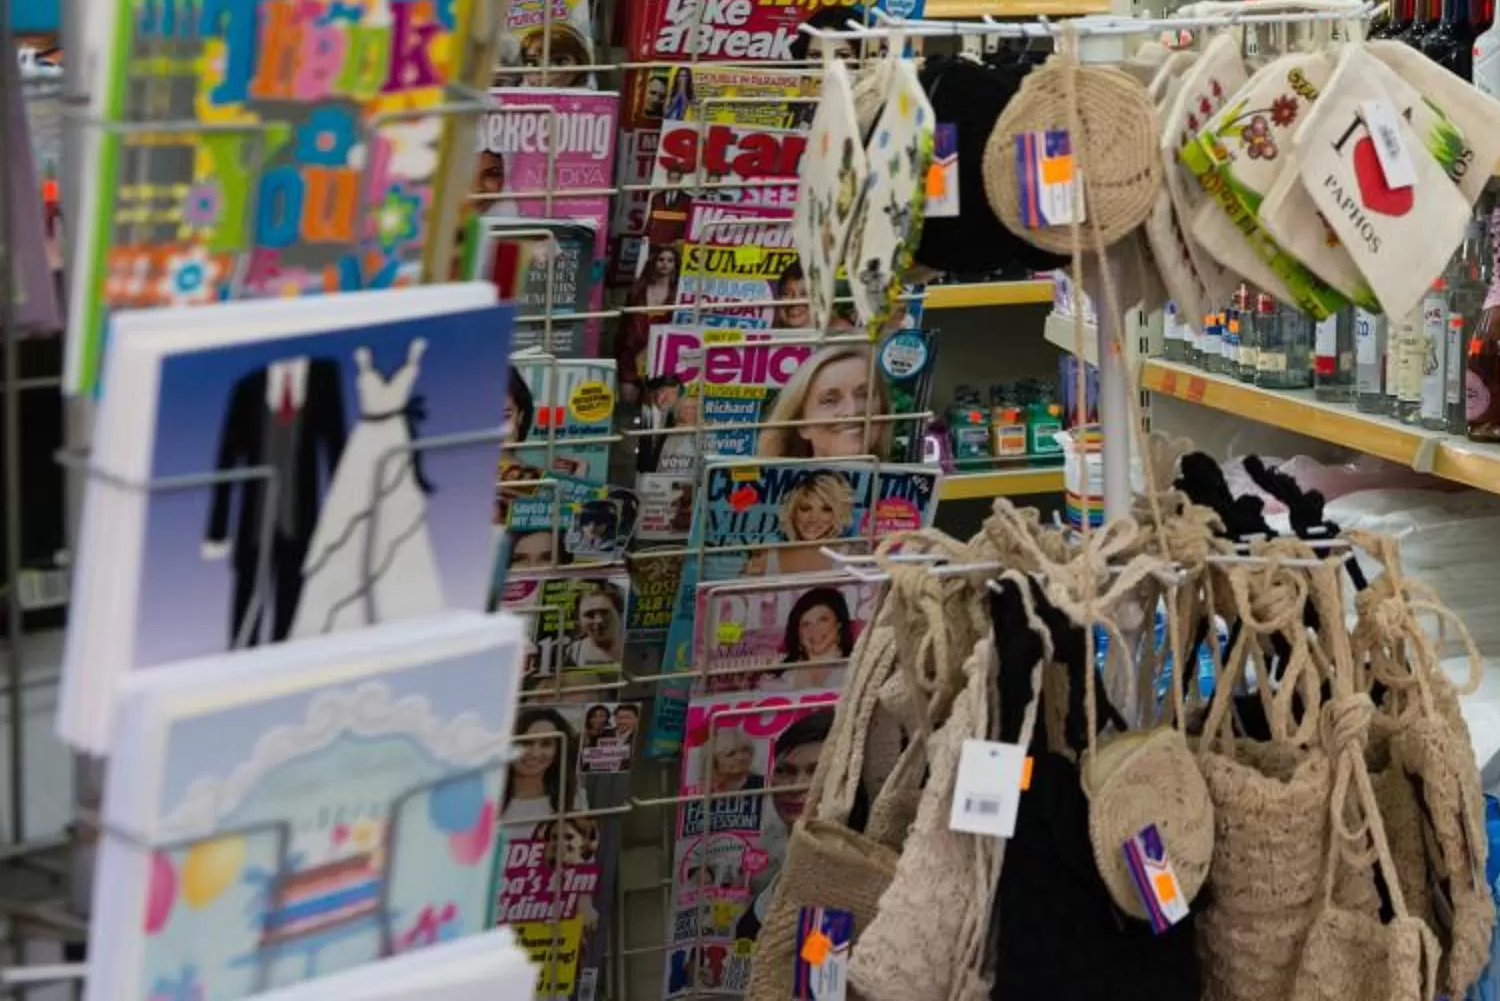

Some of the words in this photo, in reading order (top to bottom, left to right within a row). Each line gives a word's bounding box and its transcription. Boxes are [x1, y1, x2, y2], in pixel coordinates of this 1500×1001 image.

[658, 125, 808, 178] star
[522, 166, 605, 185] NDIYA
[1323, 174, 1382, 254] PAPHOS
[704, 400, 755, 415] Richard
